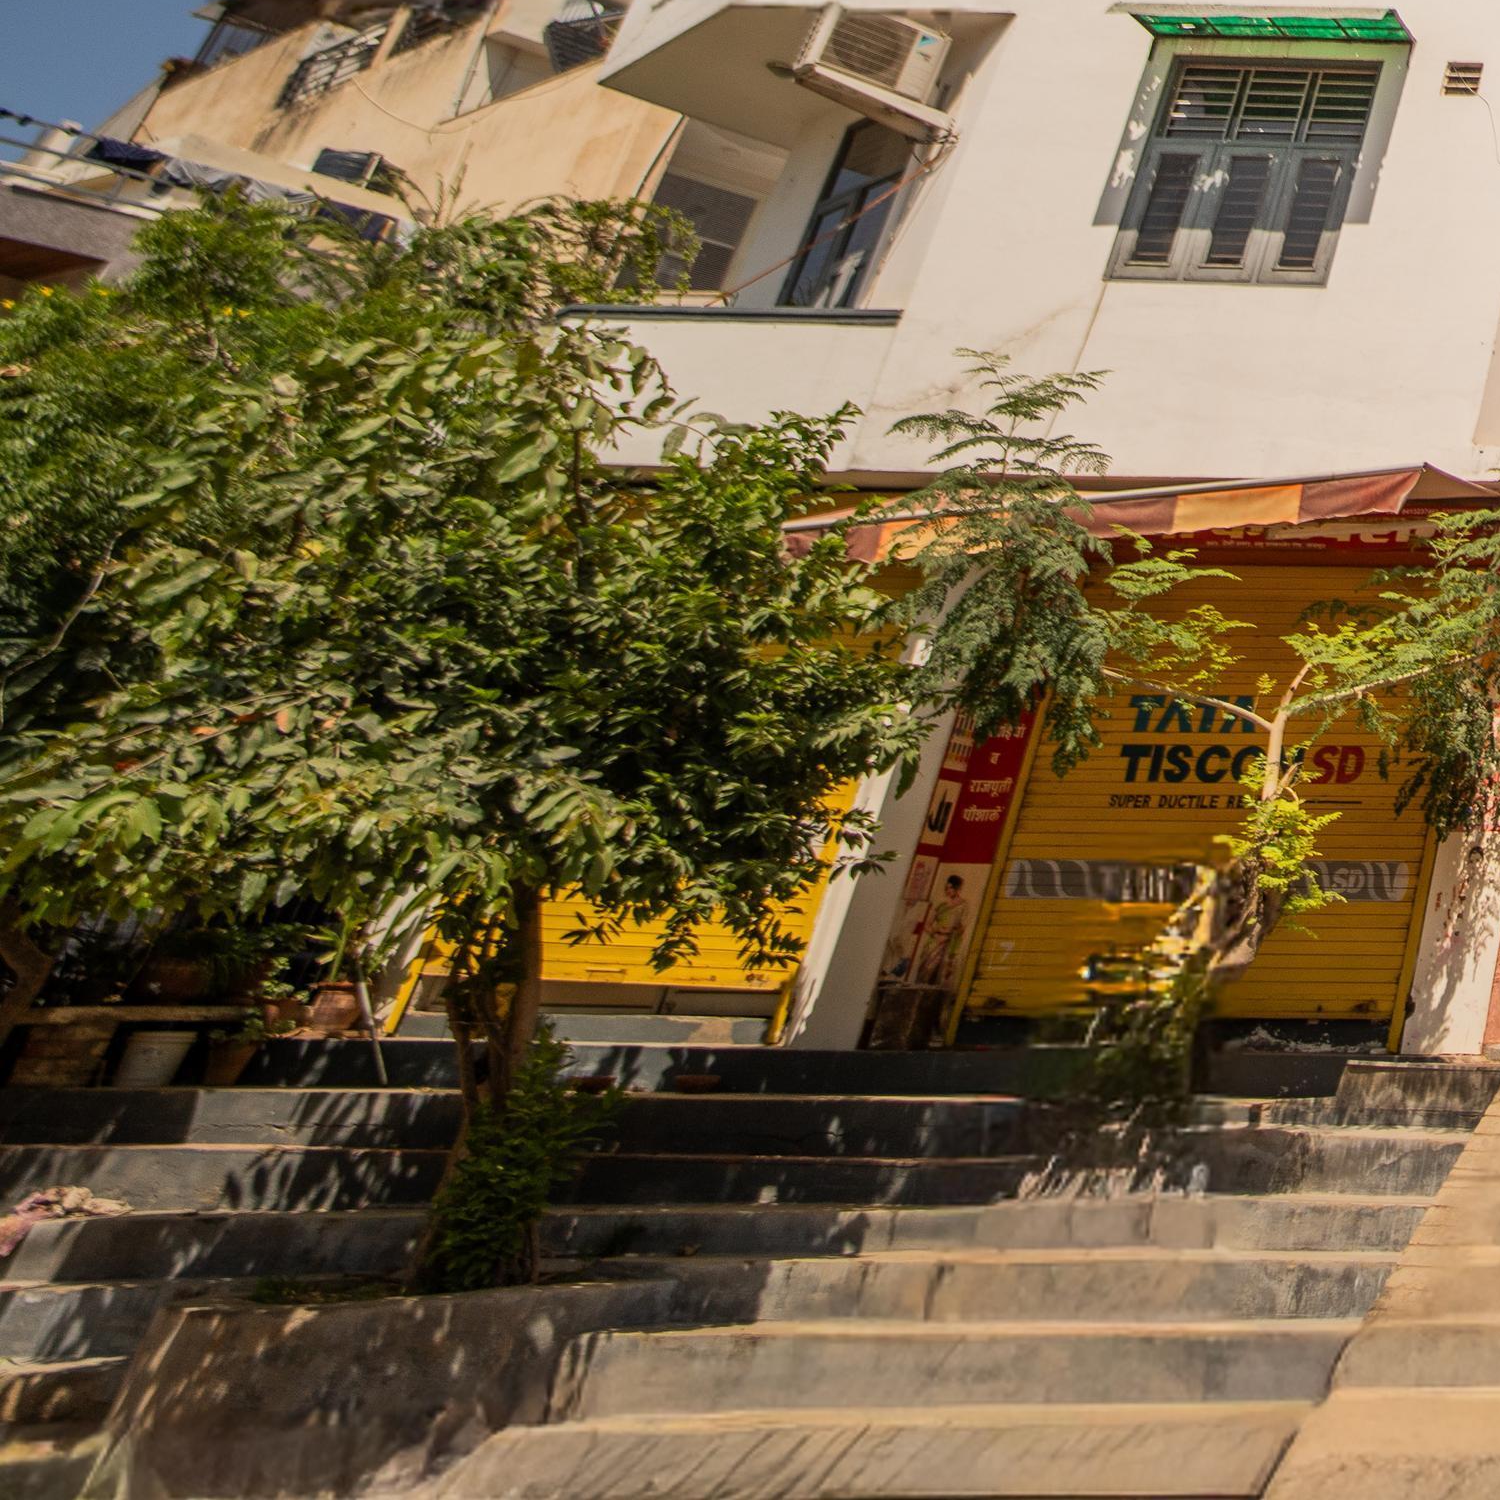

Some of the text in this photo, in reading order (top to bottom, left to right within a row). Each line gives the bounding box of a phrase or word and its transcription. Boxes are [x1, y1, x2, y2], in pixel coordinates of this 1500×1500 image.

[1129, 695, 1256, 733] TATA
[1310, 745, 1366, 784] SD
[1108, 794, 1151, 809] SUPER
[1157, 794, 1220, 809] DUCTILE
